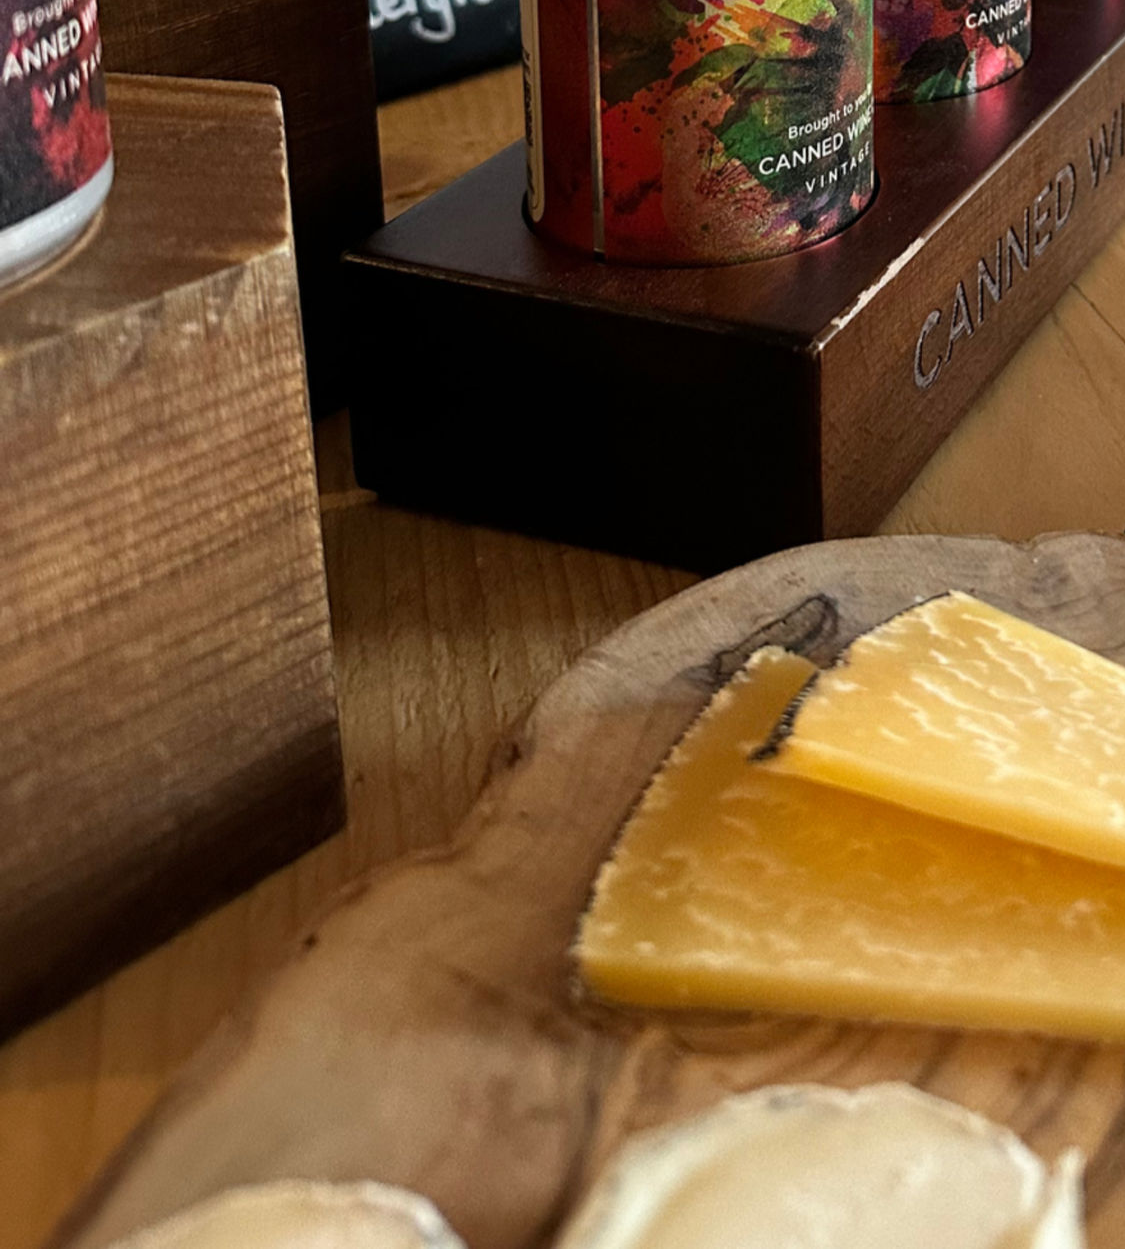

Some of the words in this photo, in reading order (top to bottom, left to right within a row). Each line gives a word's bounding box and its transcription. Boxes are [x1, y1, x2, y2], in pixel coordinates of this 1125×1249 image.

[2, 18, 81, 87] ANNED
[788, 108, 840, 140] Brought
[843, 103, 853, 117] to
[758, 132, 844, 176] CANNED
[805, 141, 870, 193] VINTAGE
[913, 162, 1077, 390] CANNED
